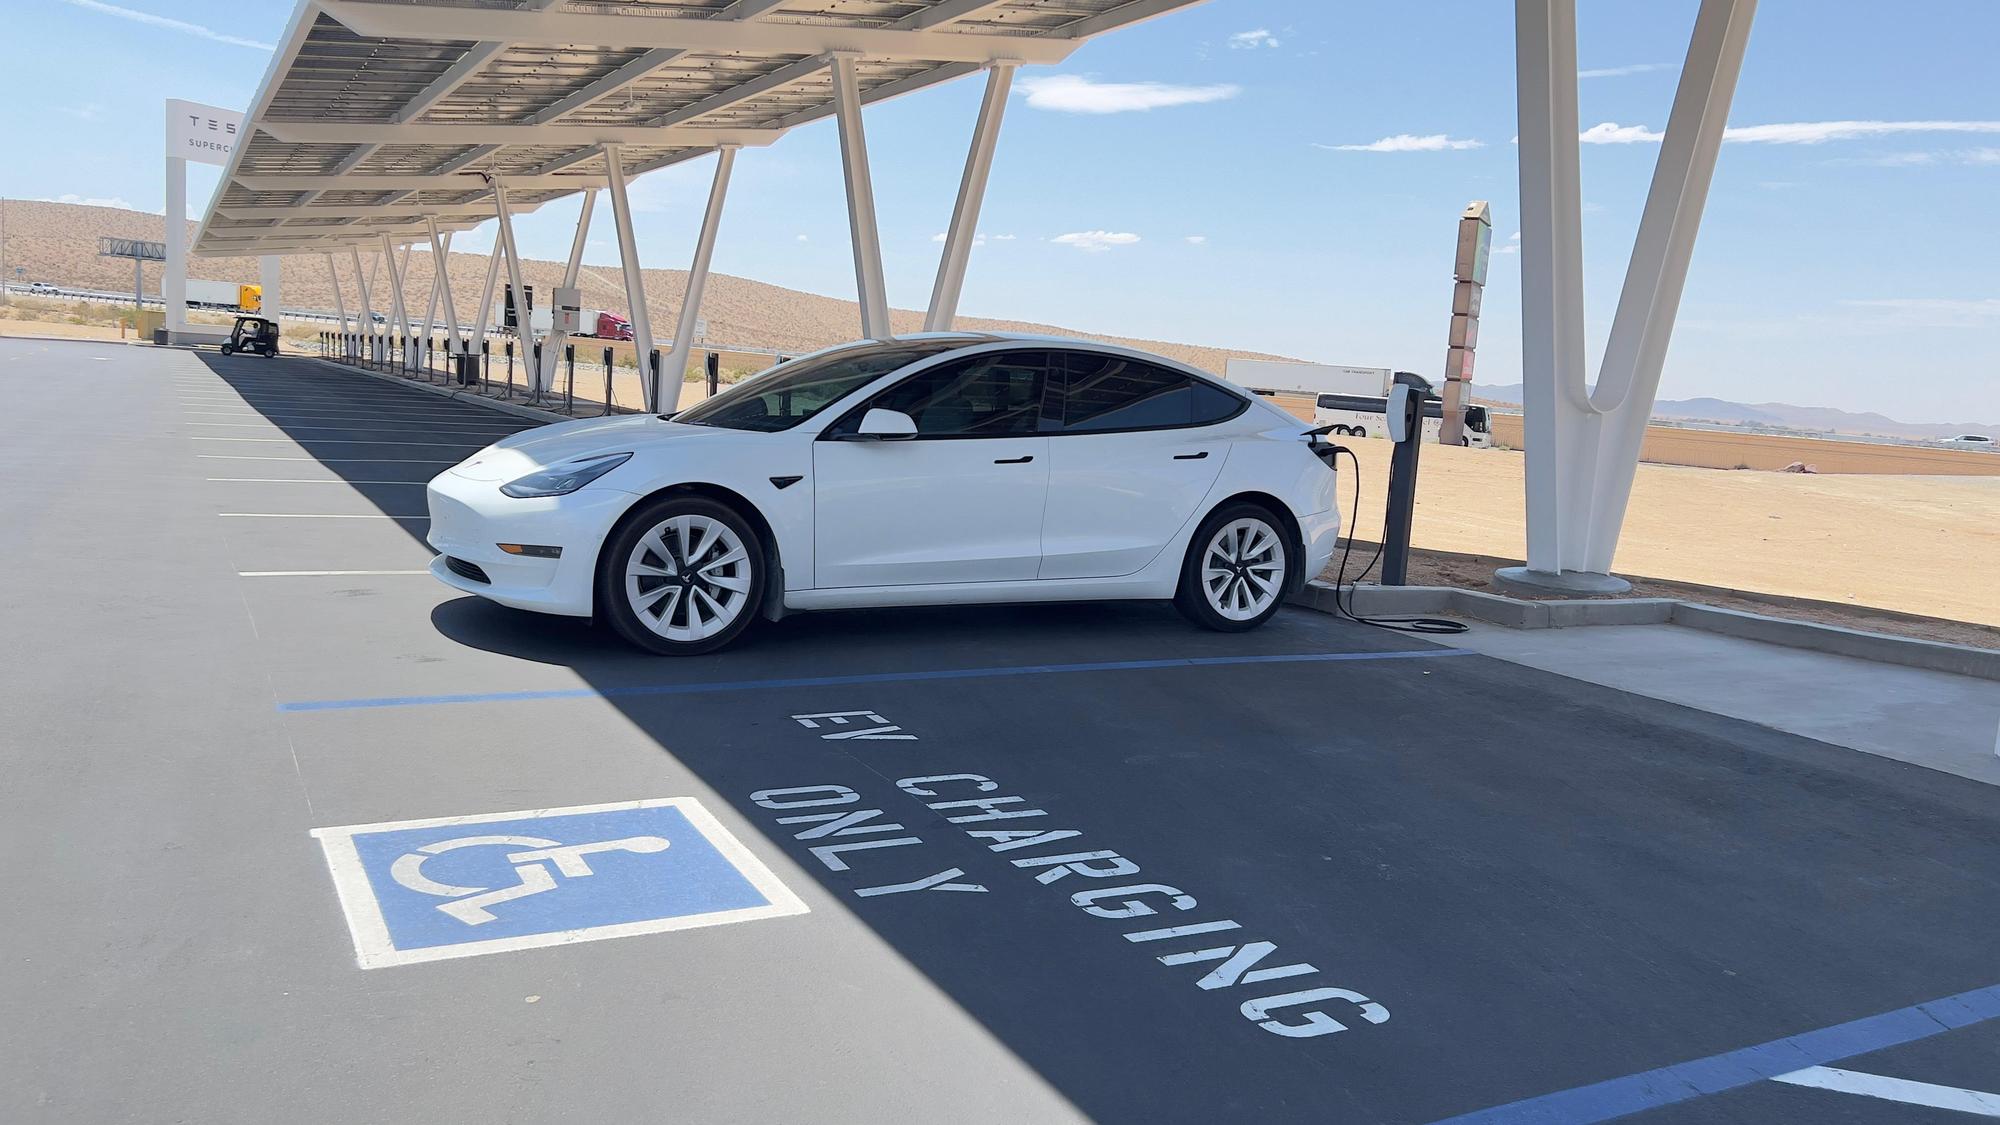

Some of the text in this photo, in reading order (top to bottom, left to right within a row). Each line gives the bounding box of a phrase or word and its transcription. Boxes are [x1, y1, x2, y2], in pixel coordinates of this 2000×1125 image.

[189, 115, 236, 134] TES
[189, 138, 233, 153] SUPERC
[749, 784, 989, 898] ONLY
[791, 710, 1391, 1039] EV CHARGING
